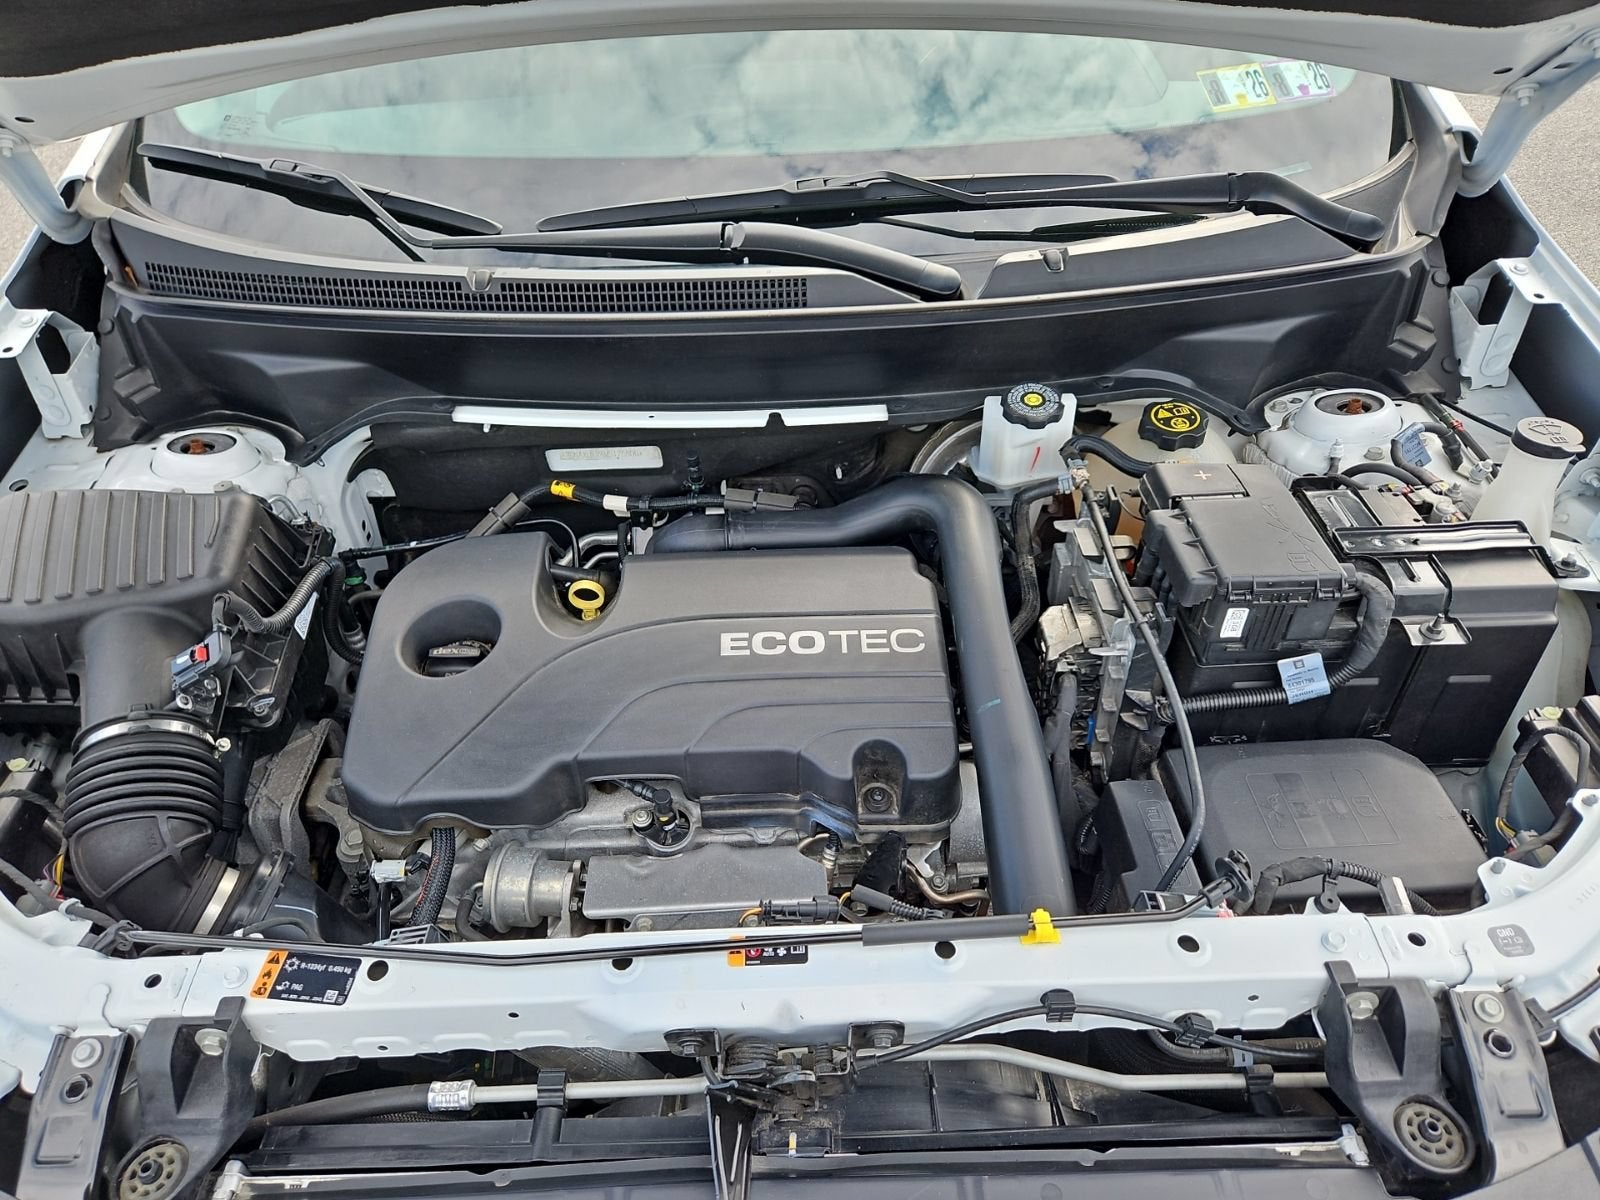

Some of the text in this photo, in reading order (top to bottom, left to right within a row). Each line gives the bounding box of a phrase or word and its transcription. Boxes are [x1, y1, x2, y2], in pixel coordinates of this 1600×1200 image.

[1245, 69, 1270, 98] 26
[1306, 62, 1331, 90] 26
[719, 628, 926, 656] ECOTEC
